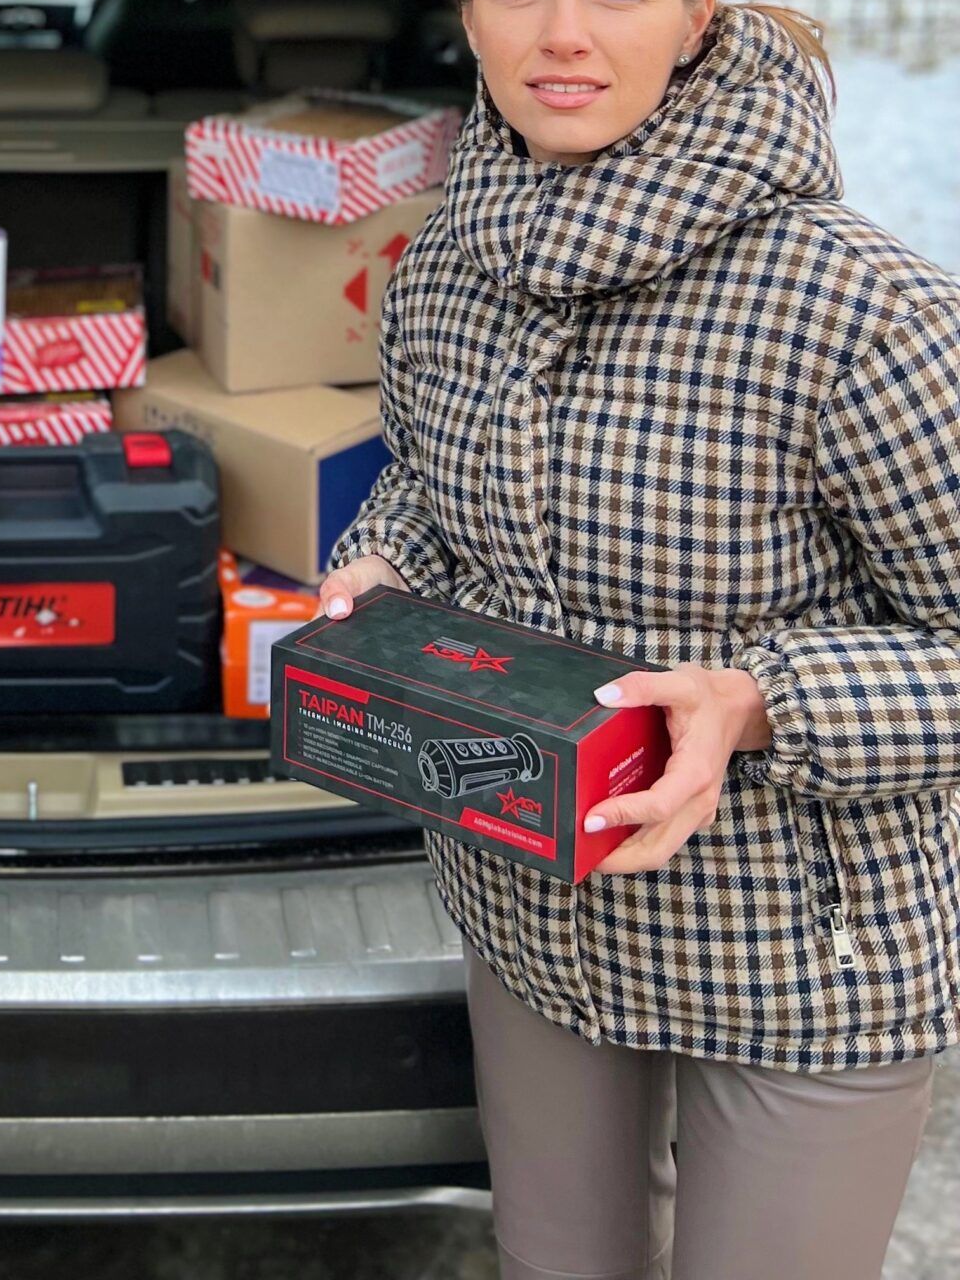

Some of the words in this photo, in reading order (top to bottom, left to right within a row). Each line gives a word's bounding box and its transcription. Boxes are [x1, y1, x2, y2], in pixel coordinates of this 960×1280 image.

[299, 689, 365, 727] TAIPAN
[366, 713, 412, 744] TM-256
[299, 707, 330, 724] THERMAL
[333, 720, 364, 735] IMAGING
[367, 732, 412, 753] MONOCULAR
